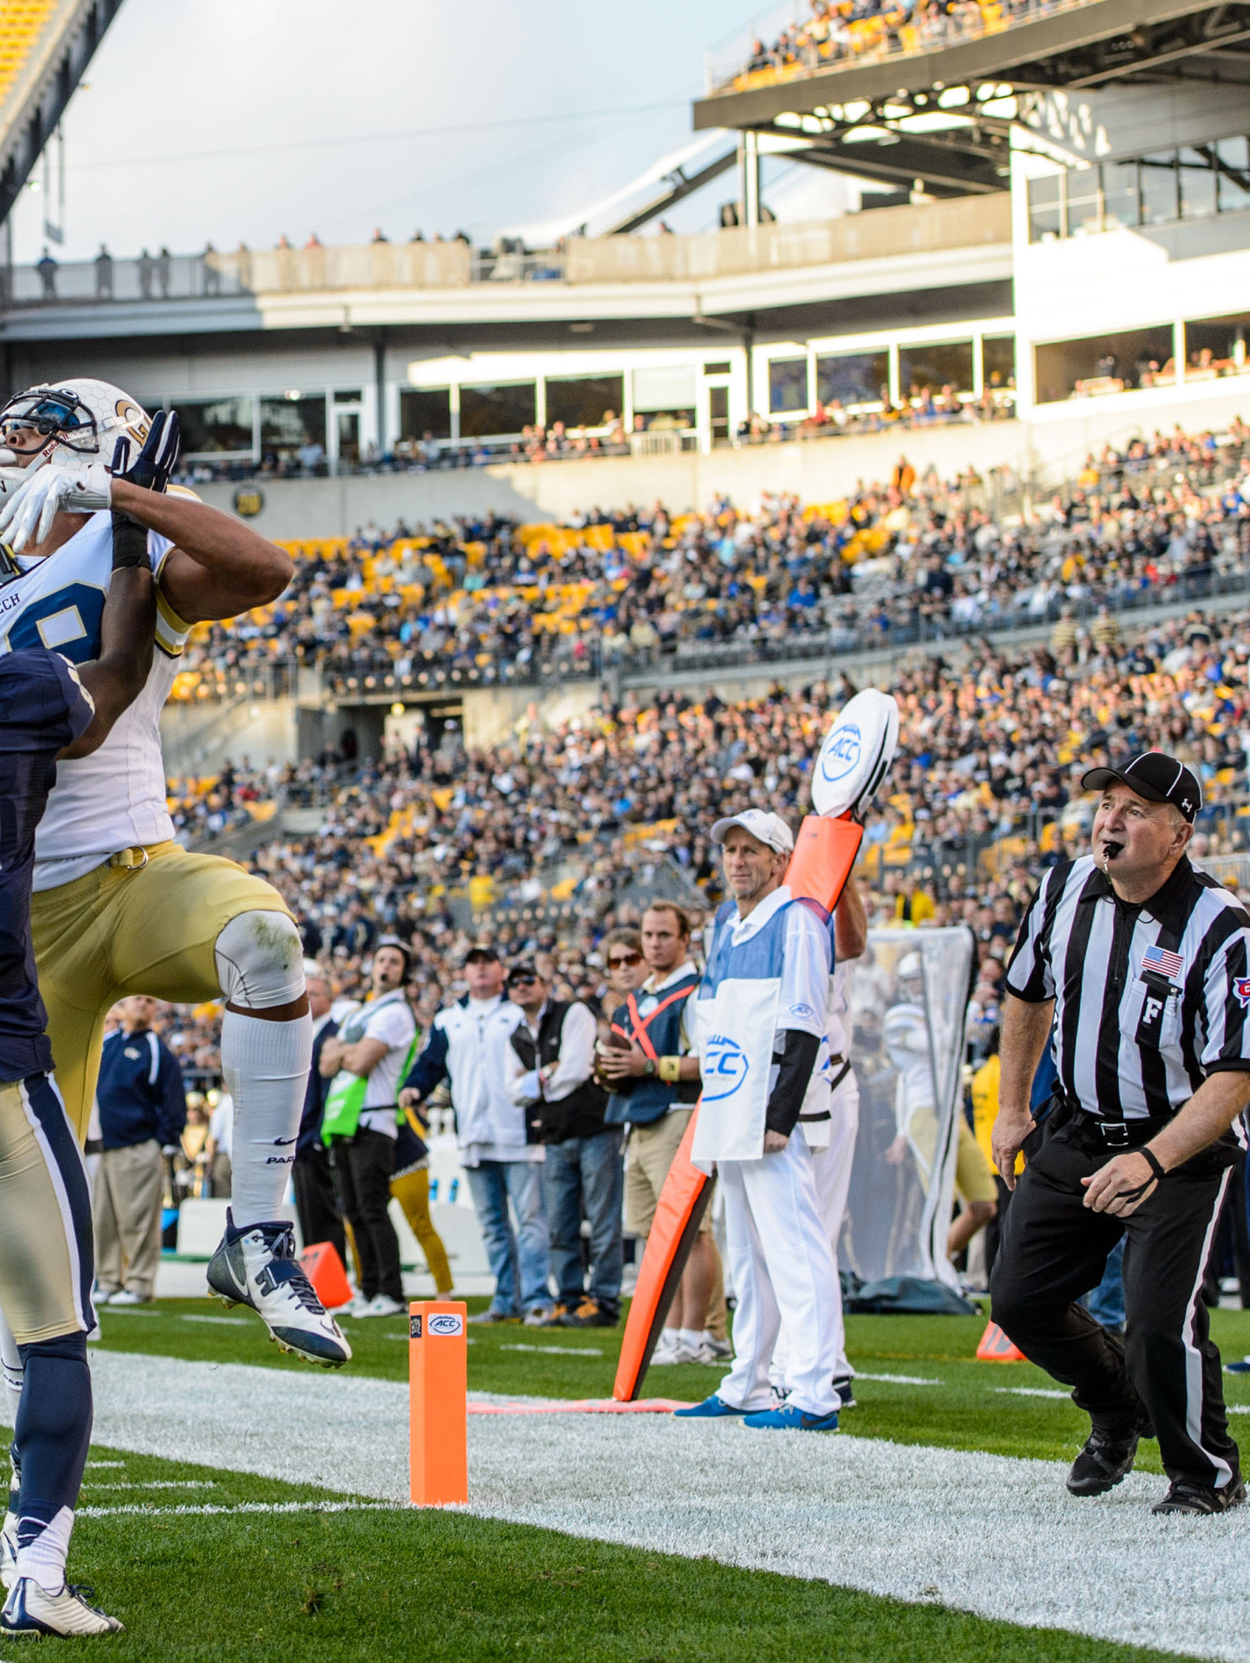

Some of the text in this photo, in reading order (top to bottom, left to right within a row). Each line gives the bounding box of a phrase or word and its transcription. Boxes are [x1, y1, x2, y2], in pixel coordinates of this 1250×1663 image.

[42, 433, 70, 458] Riddll
[827, 738, 859, 762] ACC
[1142, 996, 1164, 1025] F
